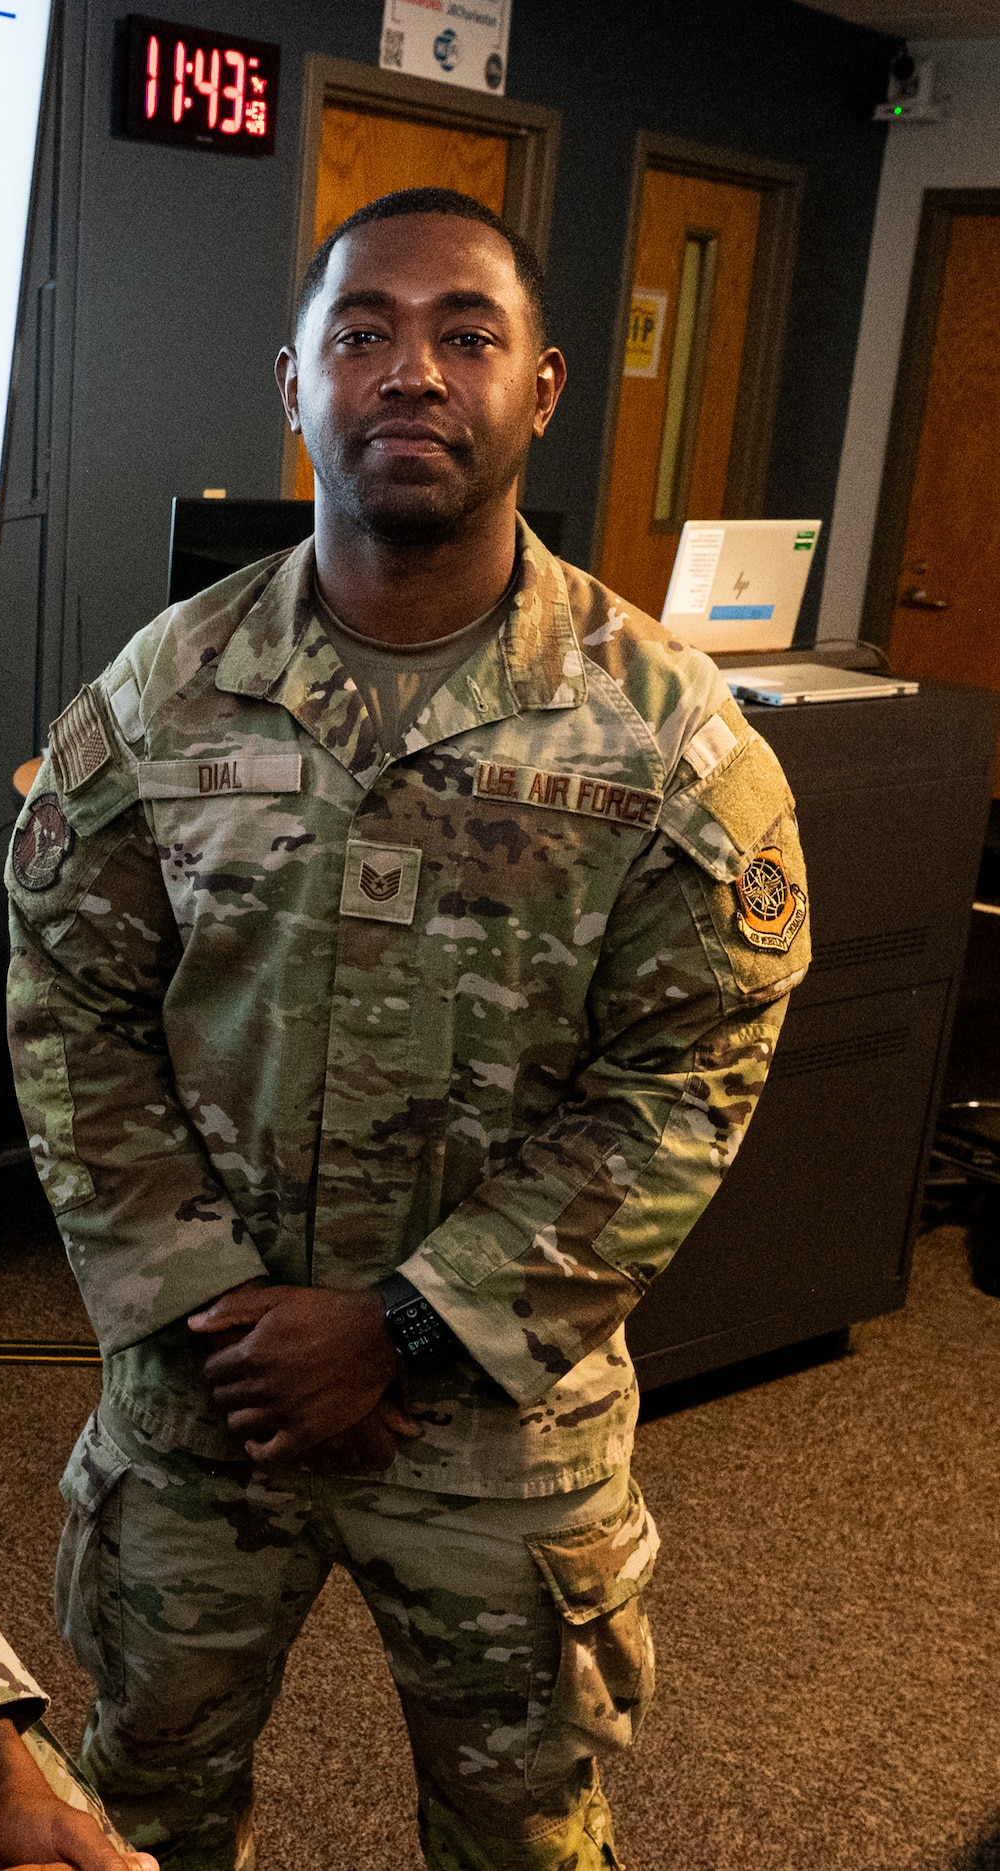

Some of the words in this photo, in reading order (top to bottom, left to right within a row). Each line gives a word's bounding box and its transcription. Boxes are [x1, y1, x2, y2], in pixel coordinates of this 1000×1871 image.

[145, 35, 246, 135] 11:43
[199, 761, 242, 792] DIAL
[477, 764, 517, 799] U.S.
[528, 773, 570, 806] AIR
[577, 780, 658, 824] FORCE
